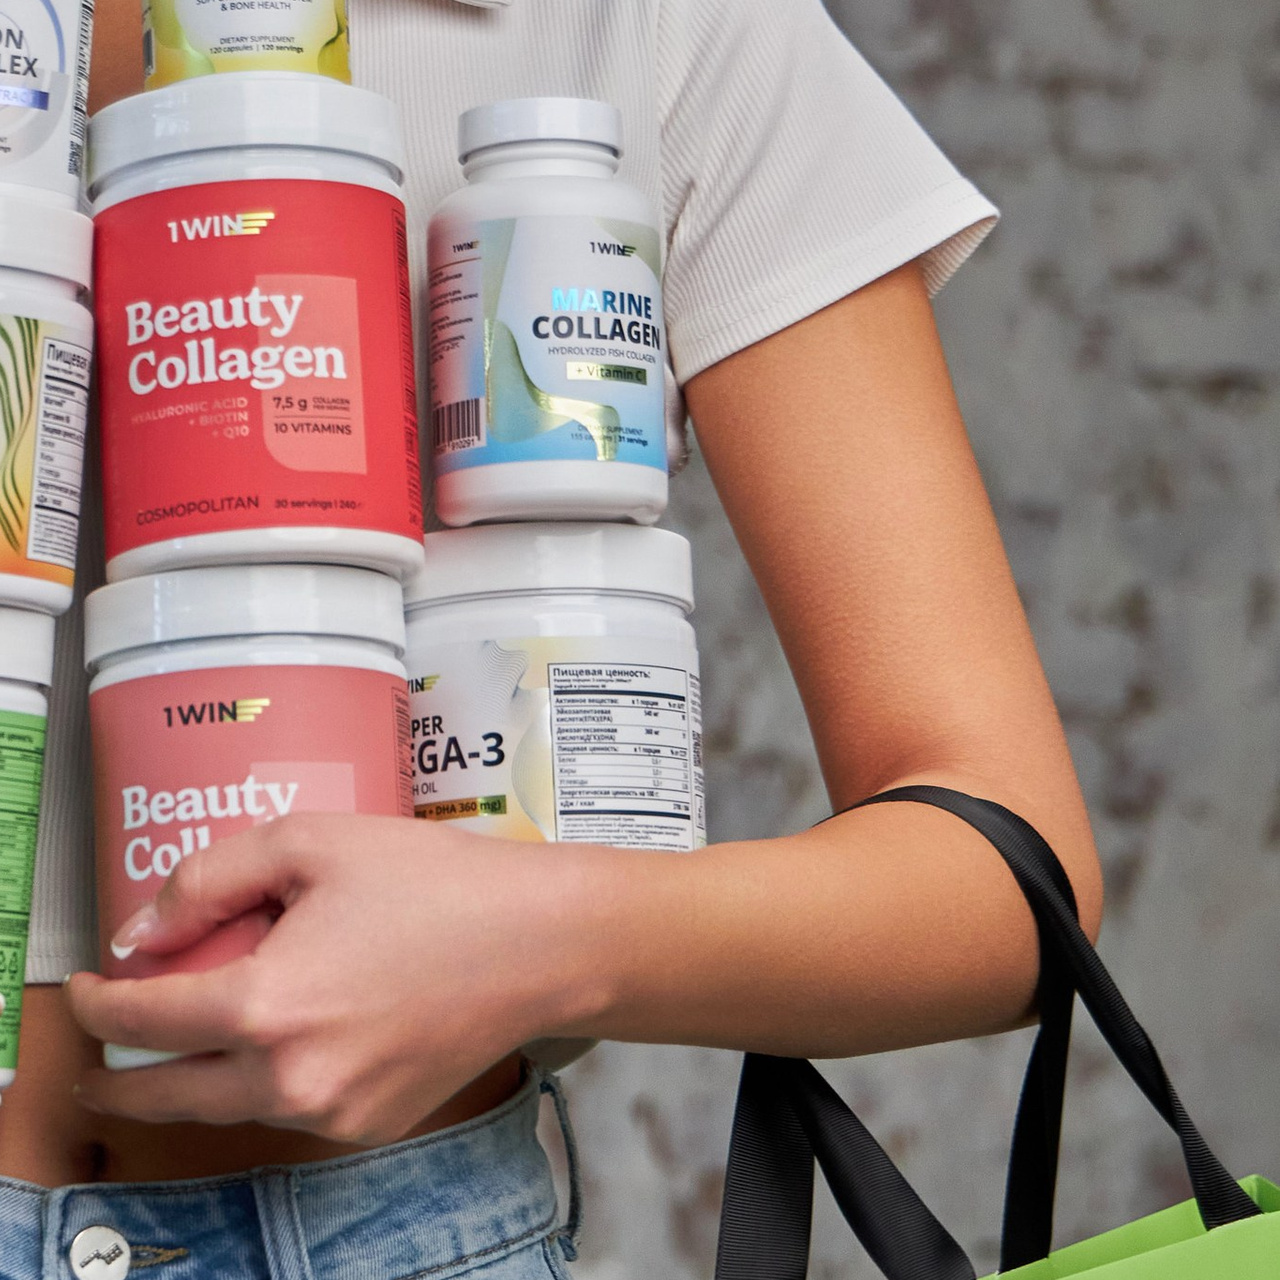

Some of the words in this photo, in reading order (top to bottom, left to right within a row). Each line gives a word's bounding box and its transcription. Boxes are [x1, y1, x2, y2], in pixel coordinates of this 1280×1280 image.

[220, 3, 228, 12] &
[230, 2, 255, 11] BONE
[258, 2, 291, 10] HEALTH
[220, 36, 248, 45] DIETARY
[223, 45, 253, 54] capsules
[276, 45, 304, 54] servings
[552, 287, 652, 320] MARINE
[125, 286, 304, 346] Beauty
[532, 316, 660, 350] COLLAGEN
[548, 346, 606, 356] HYDROLYZED
[608, 348, 624, 357] FISH
[626, 350, 656, 363] COLLAGEN
[128, 337, 347, 396] Collagen
[586, 365, 634, 380] Vitamin
[635, 370, 642, 381] C
[272, 396, 295, 410] 7,5
[297, 398, 308, 412] g
[312, 396, 350, 406] COLLAGEN
[131, 401, 208, 426] HYALURONIC
[212, 396, 249, 410] ACID
[199, 411, 249, 426] BIOTIN
[223, 426, 250, 440] Q10
[274, 422, 288, 434] 10
[292, 424, 352, 436] VITAMINS
[136, 496, 260, 526] COSMOPOLITAN
[291, 500, 332, 511] servings
[553, 668, 602, 678] Пищевая
[605, 670, 651, 679] ценность:
[420, 782, 438, 794] OIL
[122, 774, 298, 830] Beauty
[436, 804, 457, 816] DHA
[458, 802, 478, 813] 360
[480, 799, 501, 811] mg)
